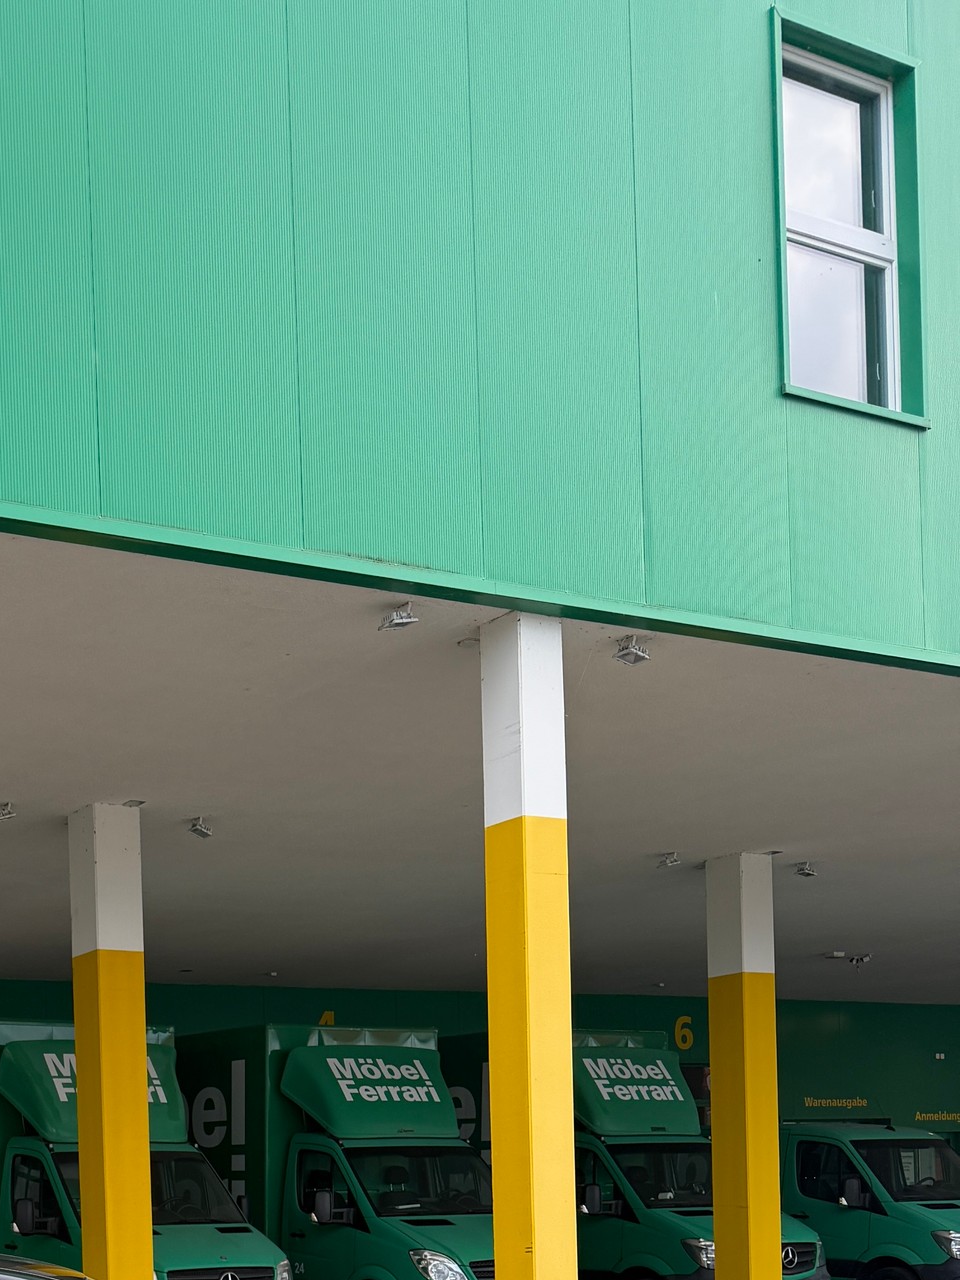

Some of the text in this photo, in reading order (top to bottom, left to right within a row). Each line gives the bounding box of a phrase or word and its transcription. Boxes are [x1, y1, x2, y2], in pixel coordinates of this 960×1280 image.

[674, 1015, 694, 1050] 6
[326, 1057, 430, 1081] Möbel
[582, 1057, 672, 1080] Möbel
[337, 1079, 441, 1103] Ferrari
[594, 1079, 685, 1101] Ferrari
[804, 1096, 868, 1109] Warenausgabe
[915, 1111, 960, 1123] Anmeldung
[294, 1262, 305, 1274] 24
